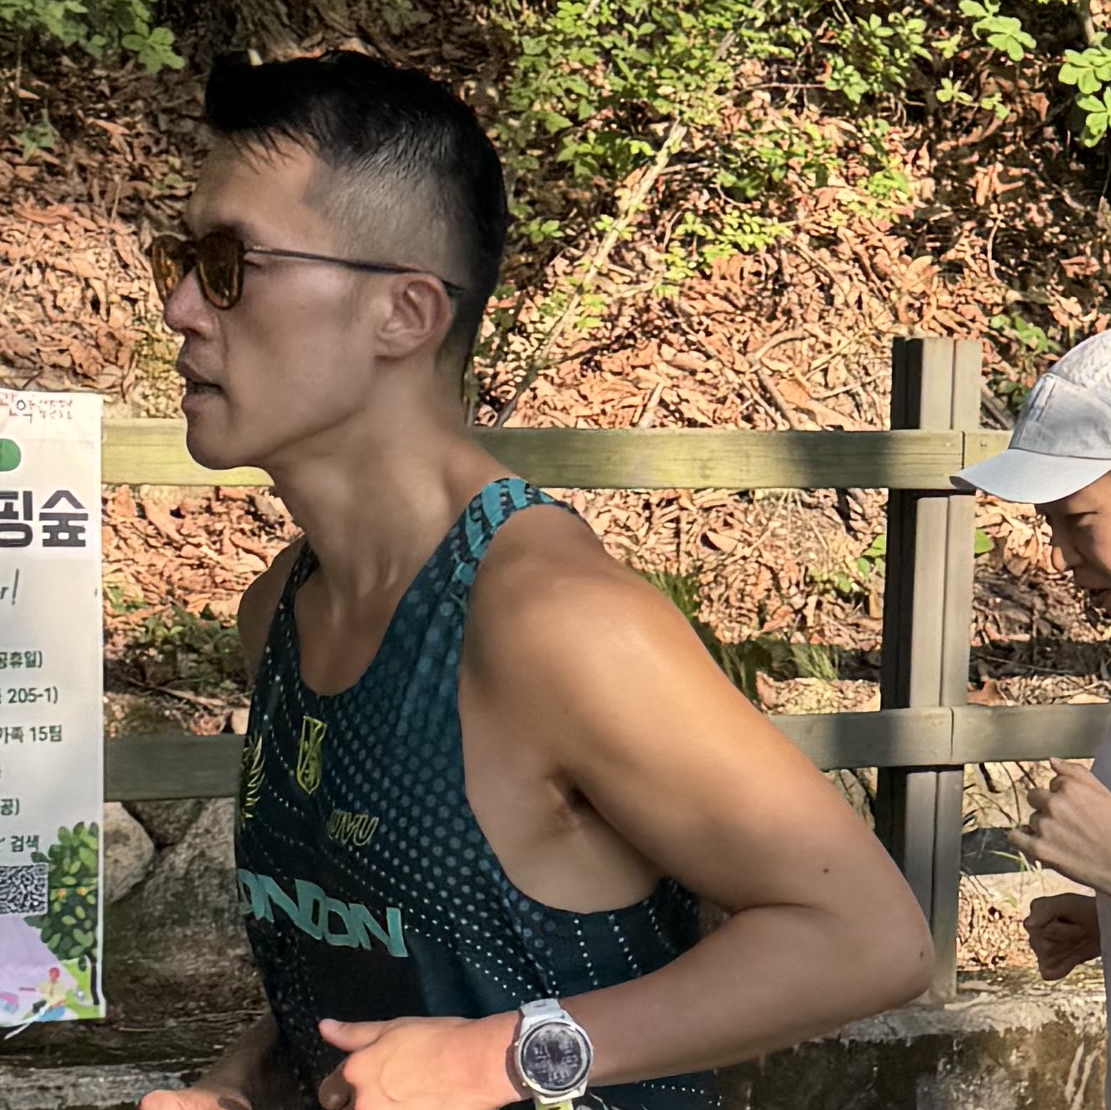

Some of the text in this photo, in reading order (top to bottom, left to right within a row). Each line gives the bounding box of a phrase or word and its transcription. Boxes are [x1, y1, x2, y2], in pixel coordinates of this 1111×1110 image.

[7, 685, 58, 705] 205-1)
[29, 724, 63, 743] 15팀
[10, 834, 40, 853] 검색
